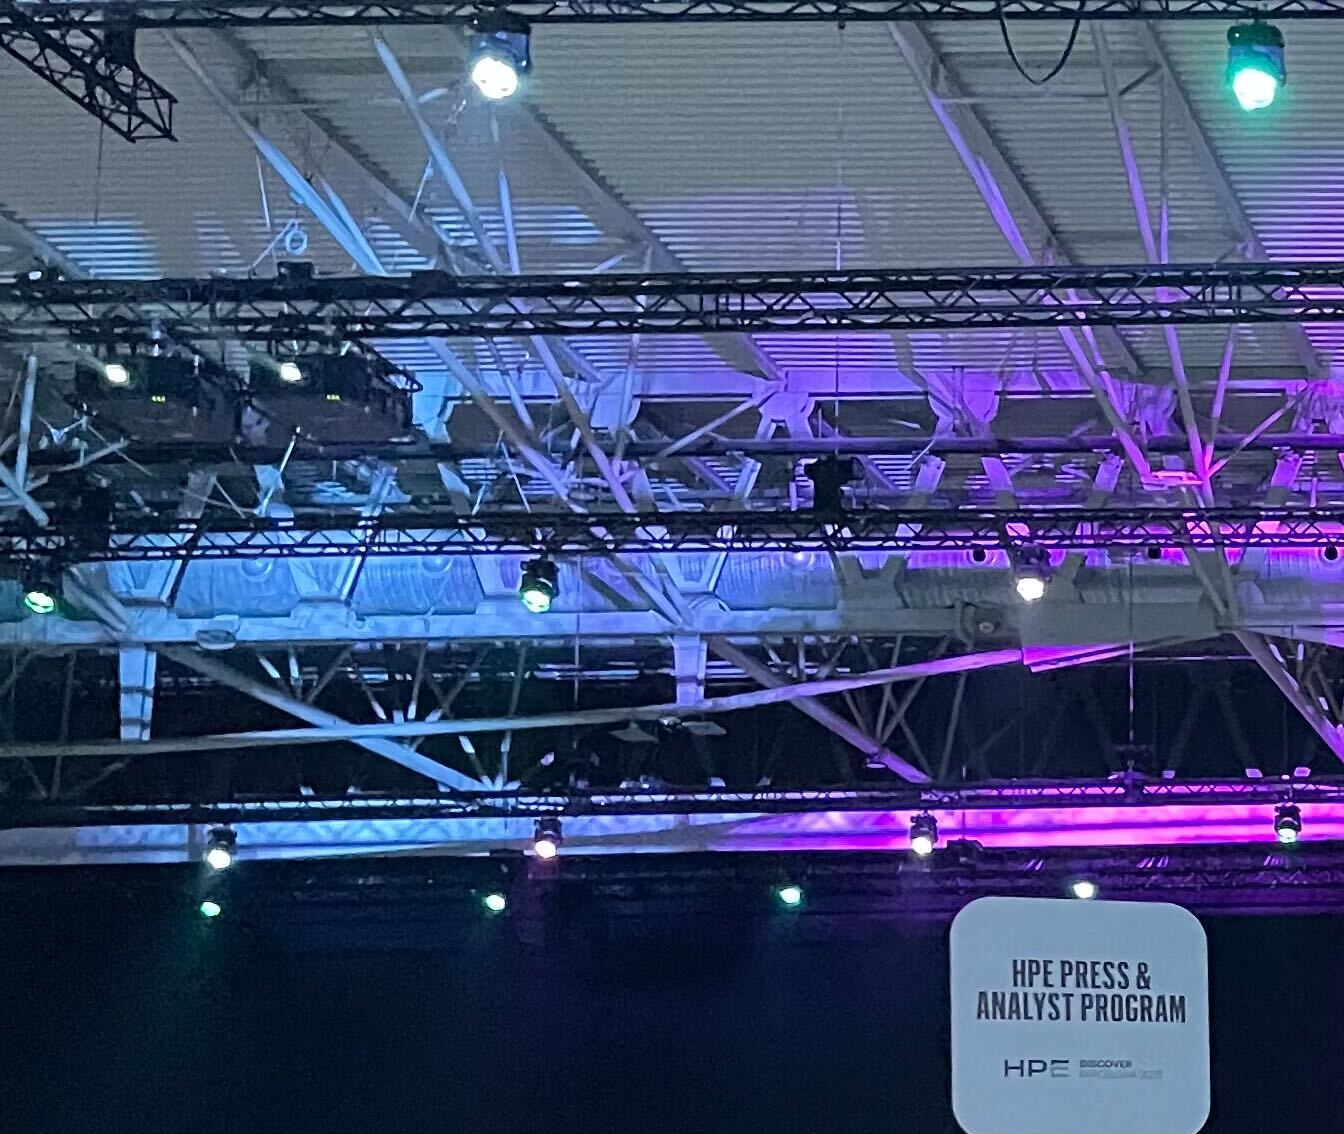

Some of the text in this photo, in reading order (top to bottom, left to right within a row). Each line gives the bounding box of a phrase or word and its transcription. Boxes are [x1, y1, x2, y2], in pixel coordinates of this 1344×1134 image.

[1012, 959, 1151, 990] HPE PRESS &
[976, 991, 1187, 1023] ANALYST PROGRAM
[1004, 1059, 1069, 1078] HPE
[1079, 1059, 1132, 1069] DISCOVER
